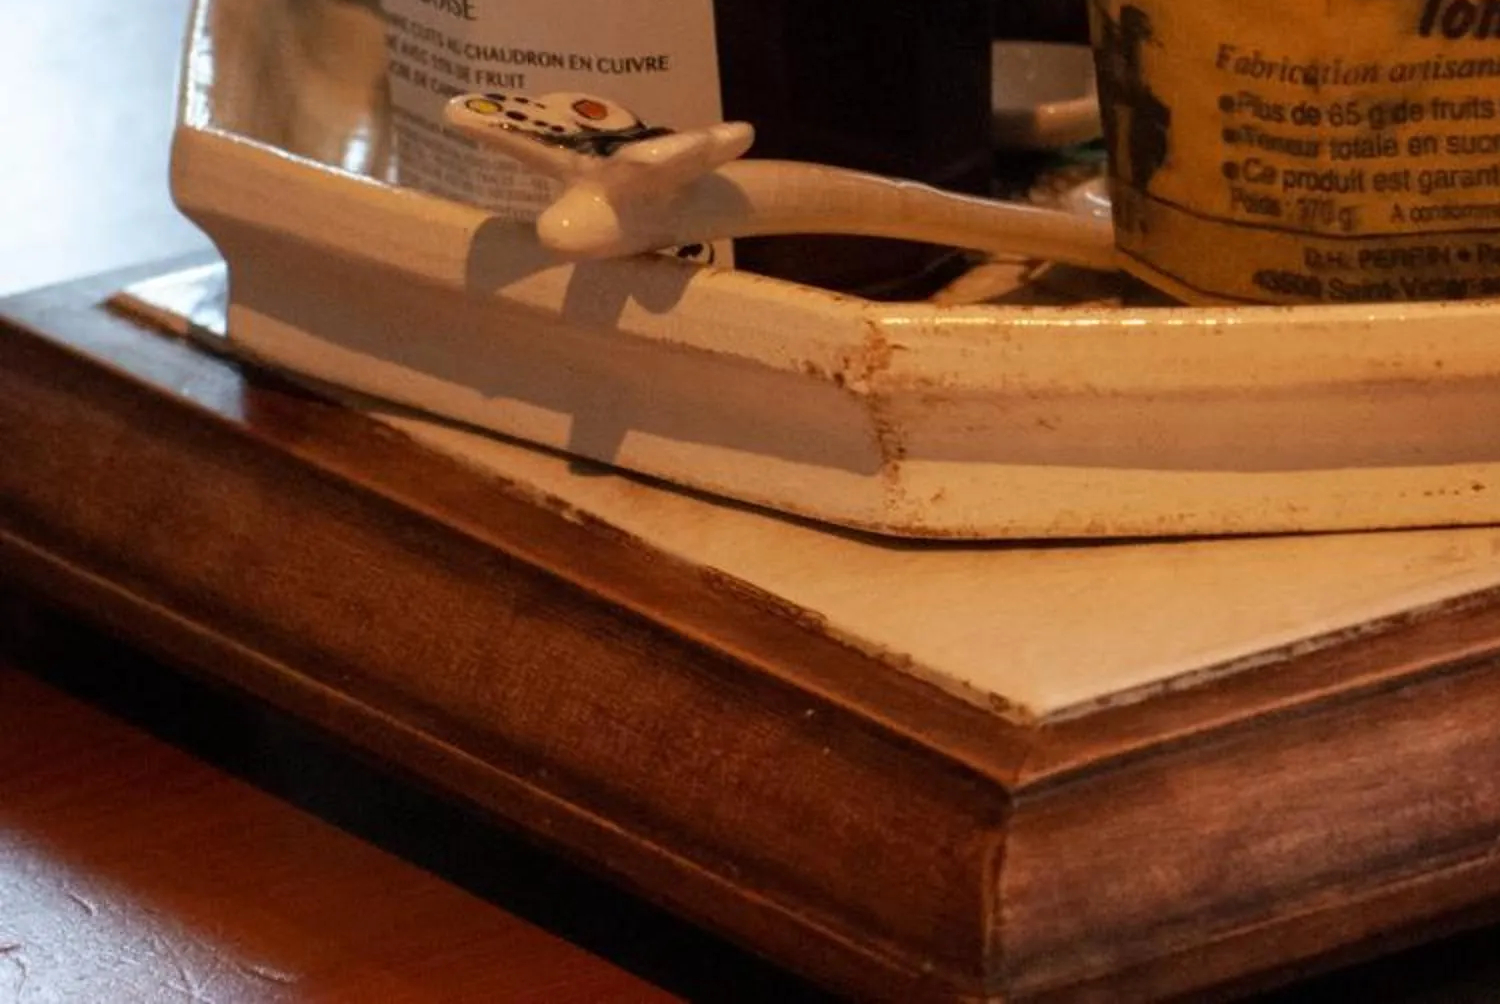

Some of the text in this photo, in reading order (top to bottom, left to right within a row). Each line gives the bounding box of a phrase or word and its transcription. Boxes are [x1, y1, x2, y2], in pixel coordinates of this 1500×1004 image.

[463, 43, 563, 70] CHAUDRON
[569, 53, 592, 73] EN
[596, 52, 670, 74] CUIVRE
[1215, 43, 1379, 86] Fabrication
[474, 69, 525, 90] FRUIT
[1290, 101, 1322, 128] de
[1368, 104, 1388, 131] g
[1390, 99, 1424, 126] de
[1431, 96, 1495, 122] fruits
[1329, 134, 1399, 161] totale
[1407, 135, 1438, 158] en
[1242, 156, 1277, 186] Ce
[1282, 165, 1366, 195] produit
[1372, 167, 1411, 193] est
[1338, 204, 1358, 230] g
